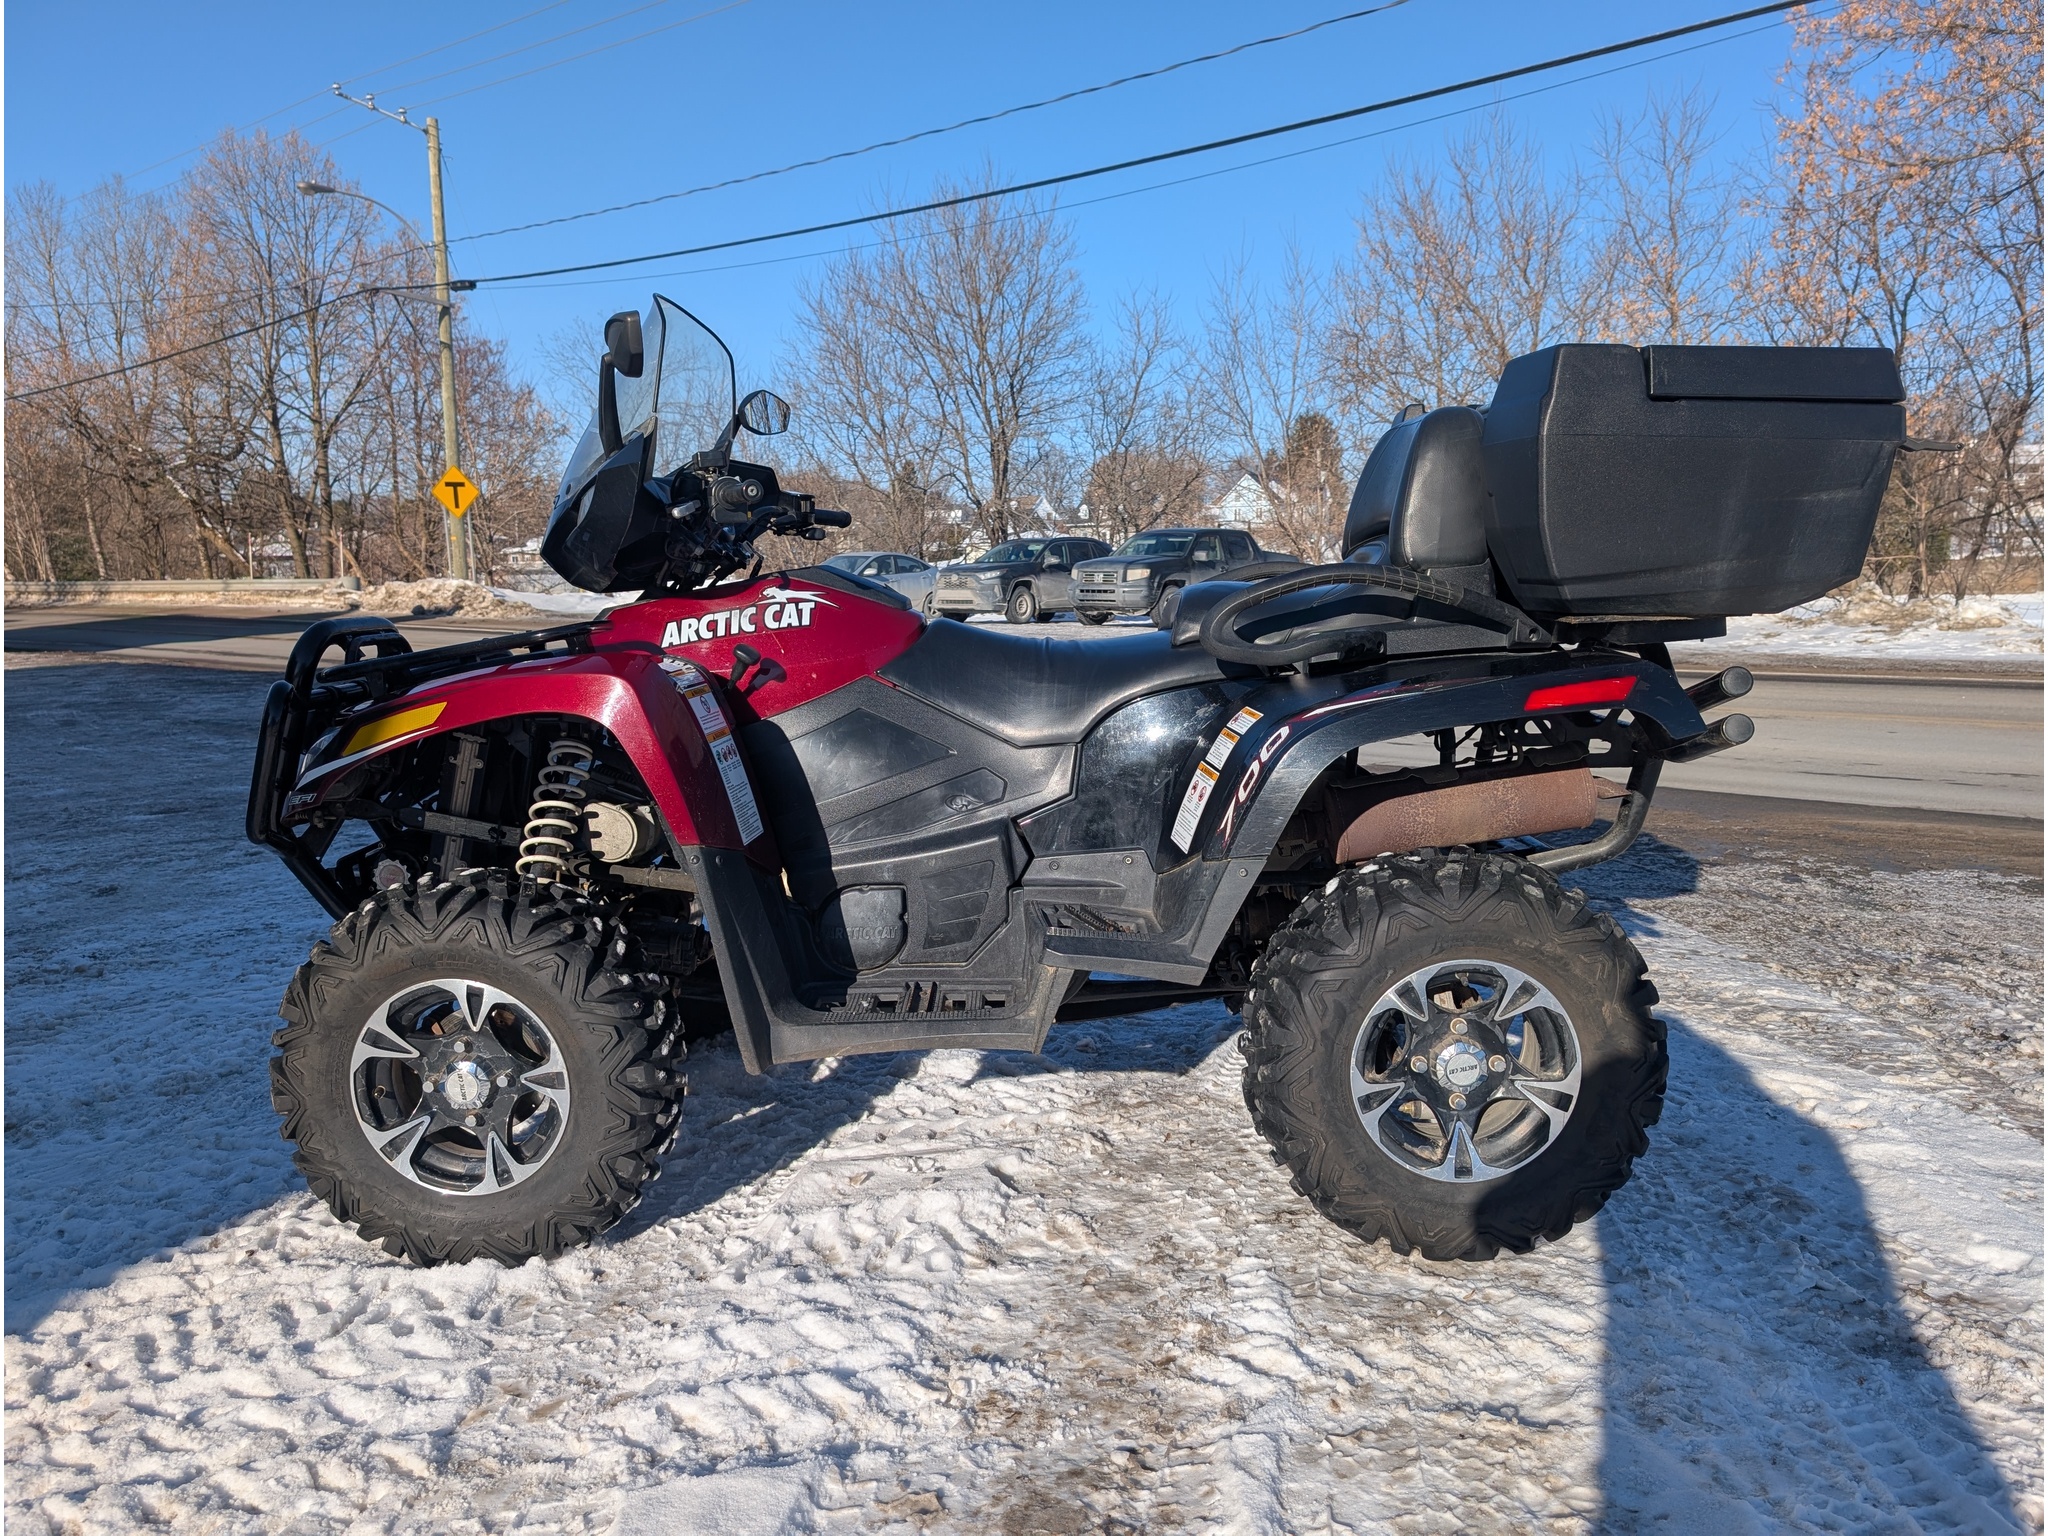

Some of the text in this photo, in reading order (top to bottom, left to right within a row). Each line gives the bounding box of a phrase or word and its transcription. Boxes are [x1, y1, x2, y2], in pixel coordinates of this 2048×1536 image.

[661, 602, 815, 648] ARCTIC CAT
[1217, 724, 1290, 845] 700
[826, 926, 897, 940] ARCTIC CAT
[1460, 1064, 1478, 1073] ARCTIC
[459, 1083, 467, 1101] ARCTIC
